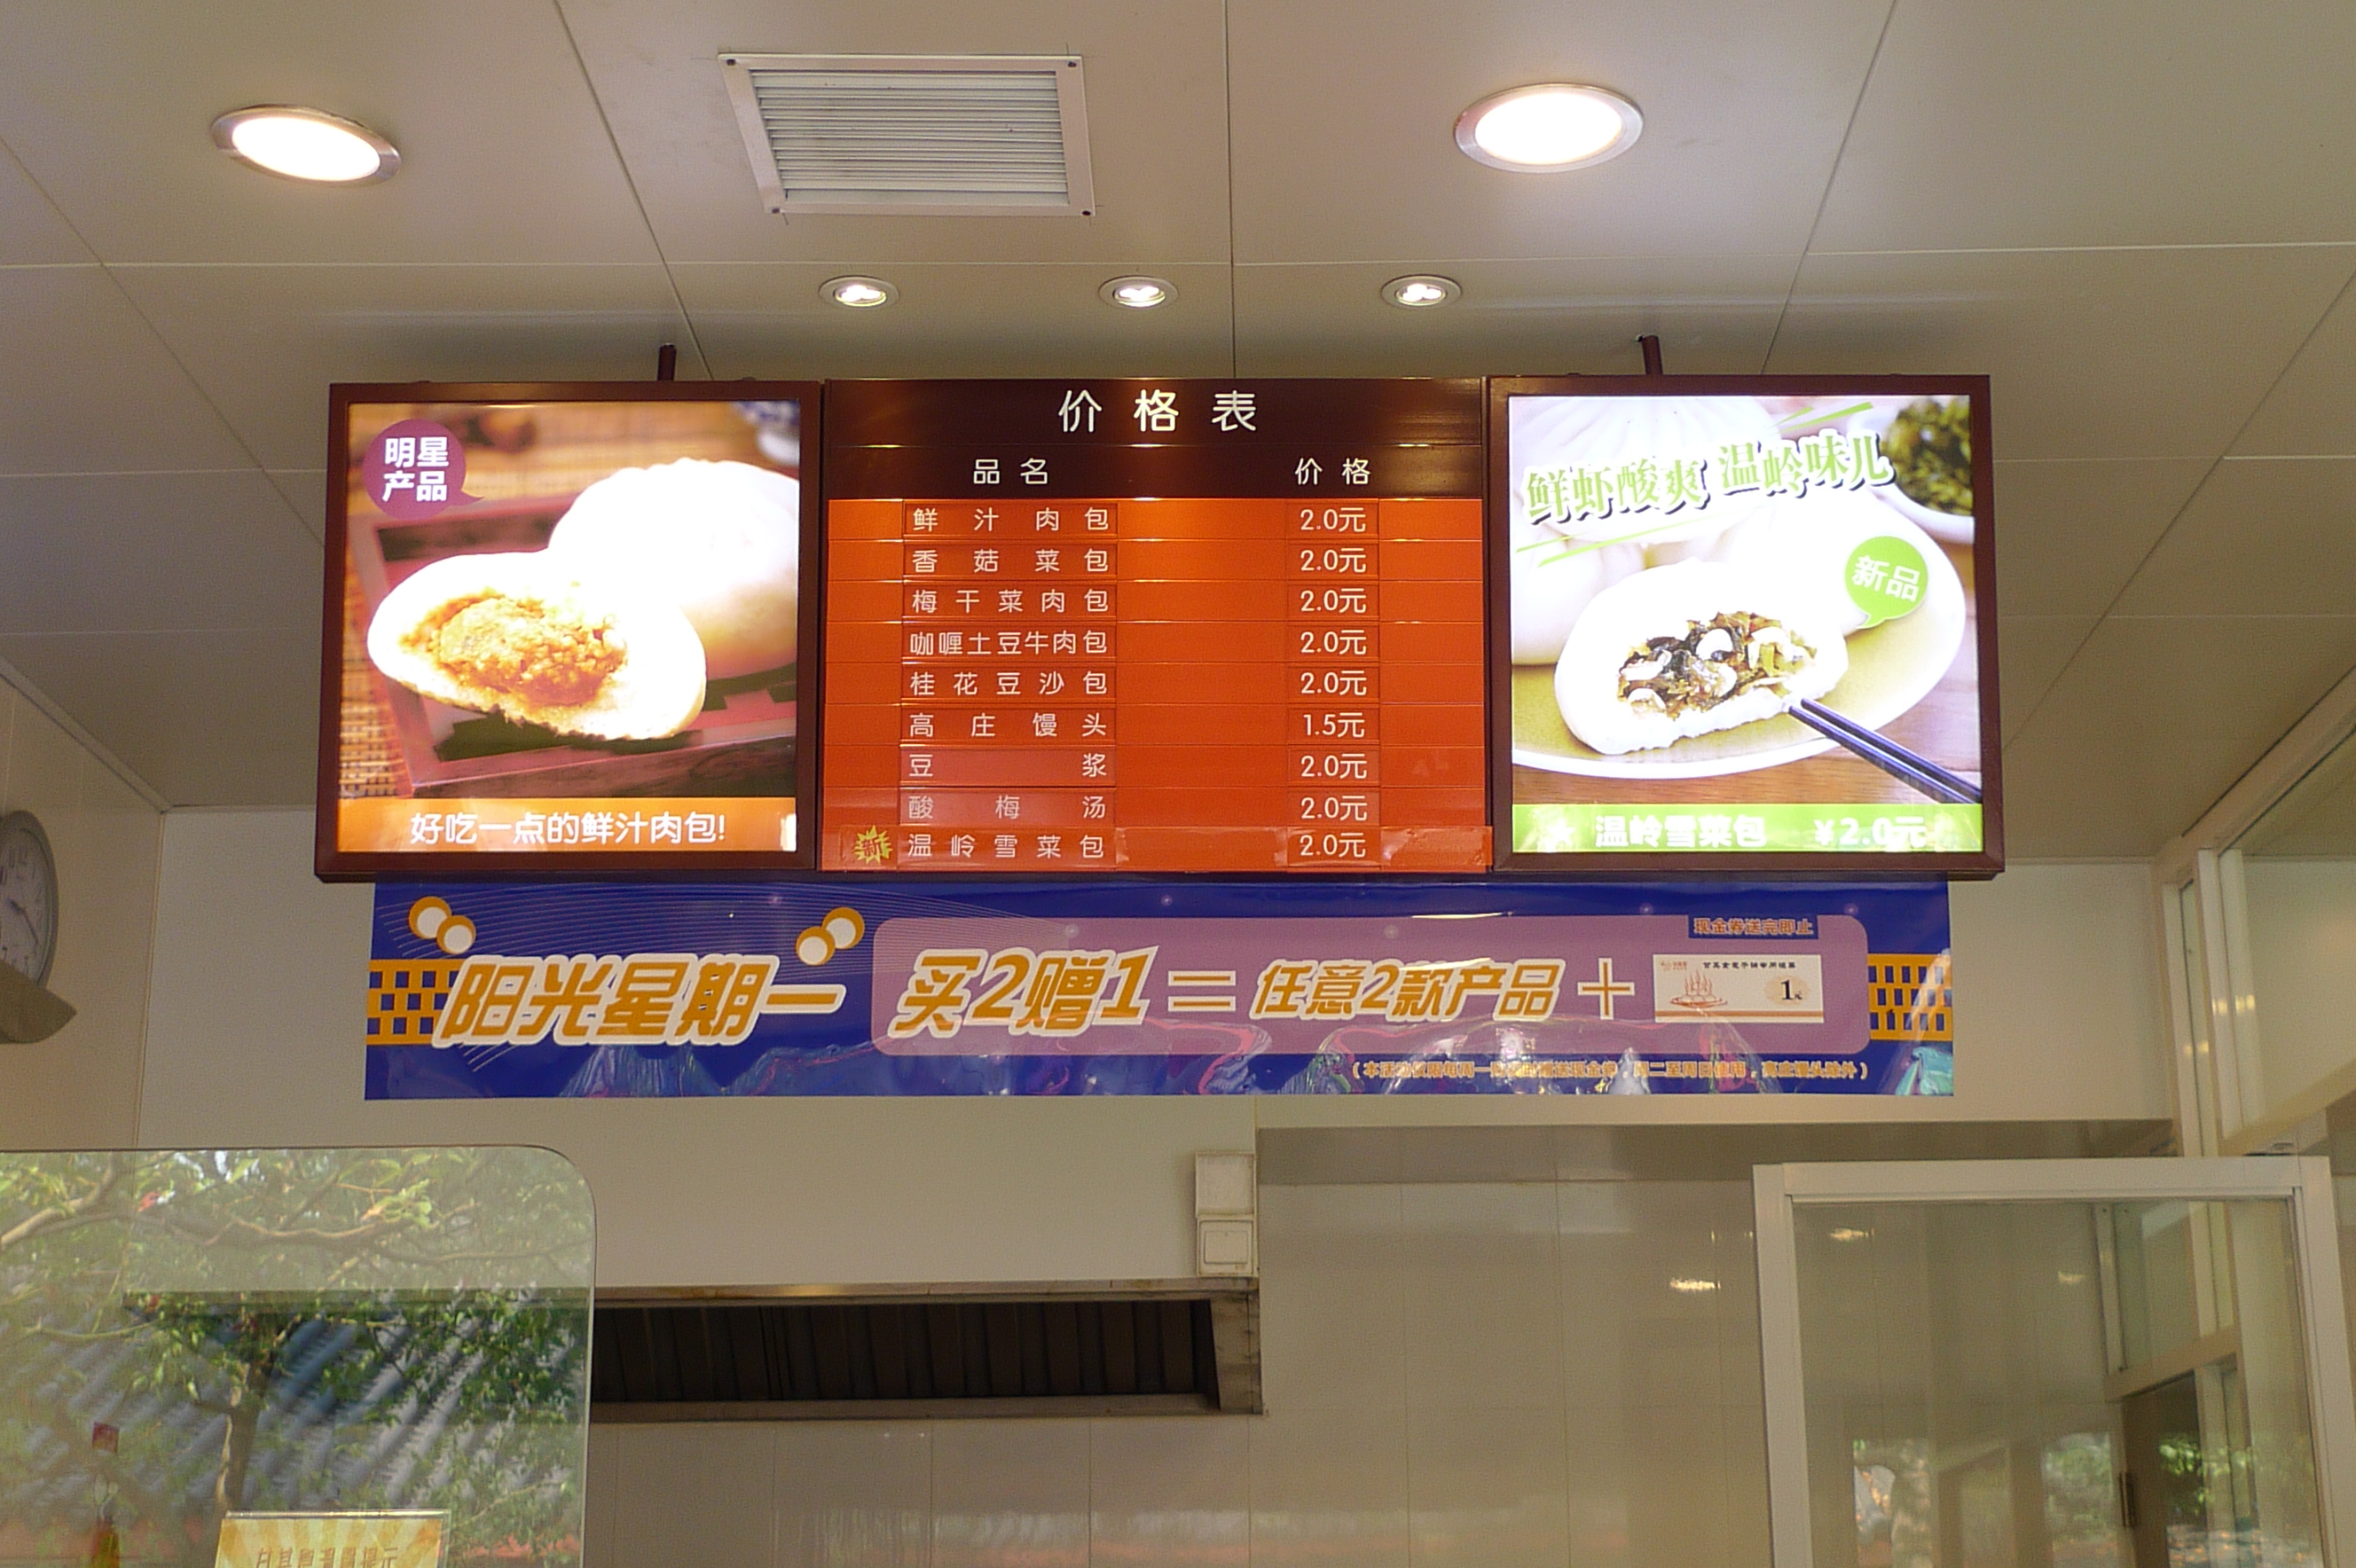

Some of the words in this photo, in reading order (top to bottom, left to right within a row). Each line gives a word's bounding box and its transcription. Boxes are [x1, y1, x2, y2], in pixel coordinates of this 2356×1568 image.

[1058, 389, 1257, 433] 价格表
[383, 436, 449, 470] 明星
[973, 459, 1048, 485] 品名
[1295, 458, 1370, 486] 价格
[1526, 457, 1708, 524] 鲜虾酸爽
[1719, 429, 1896, 498] 温岭味儿
[382, 471, 448, 503] 产品
[913, 507, 1109, 532] 鲜汁肉包
[1300, 507, 1367, 533] 2.0元
[912, 549, 1109, 574] 香菇菜包
[1300, 547, 1367, 573] 2.0元
[1851, 555, 1920, 602] 新品
[912, 590, 1108, 614] 梅干菜肉包
[1300, 588, 1367, 614] 2.0元
[910, 631, 1107, 656] 咖喱土豆牛肉包
[1300, 630, 1367, 655] 2.0元
[910, 672, 1107, 696] 桂花豆沙包
[1300, 670, 1367, 695] 2.0元
[909, 713, 1107, 738] 高庄馒头
[1303, 713, 1367, 738] 1.5元
[909, 753, 1107, 778] 豆浆
[1300, 754, 1367, 779] 2.0元
[908, 796, 1106, 819] 酸梅汤
[1300, 796, 1367, 821] 2.0元
[411, 812, 726, 844] 好吃一点的鲜汁肉包!
[1595, 815, 1766, 849] 温岭雪菜包
[1814, 816, 1927, 849] ¥2.0元
[907, 834, 1104, 858] 温岭雪菜包
[1300, 833, 1367, 858] 2.0元
[1693, 917, 1814, 935] 现金券送完即止
[433, 954, 845, 1047] 阳光星期一
[888, 945, 1158, 1039] 买2赠1
[1249, 958, 1566, 1021] 任意2款产品
